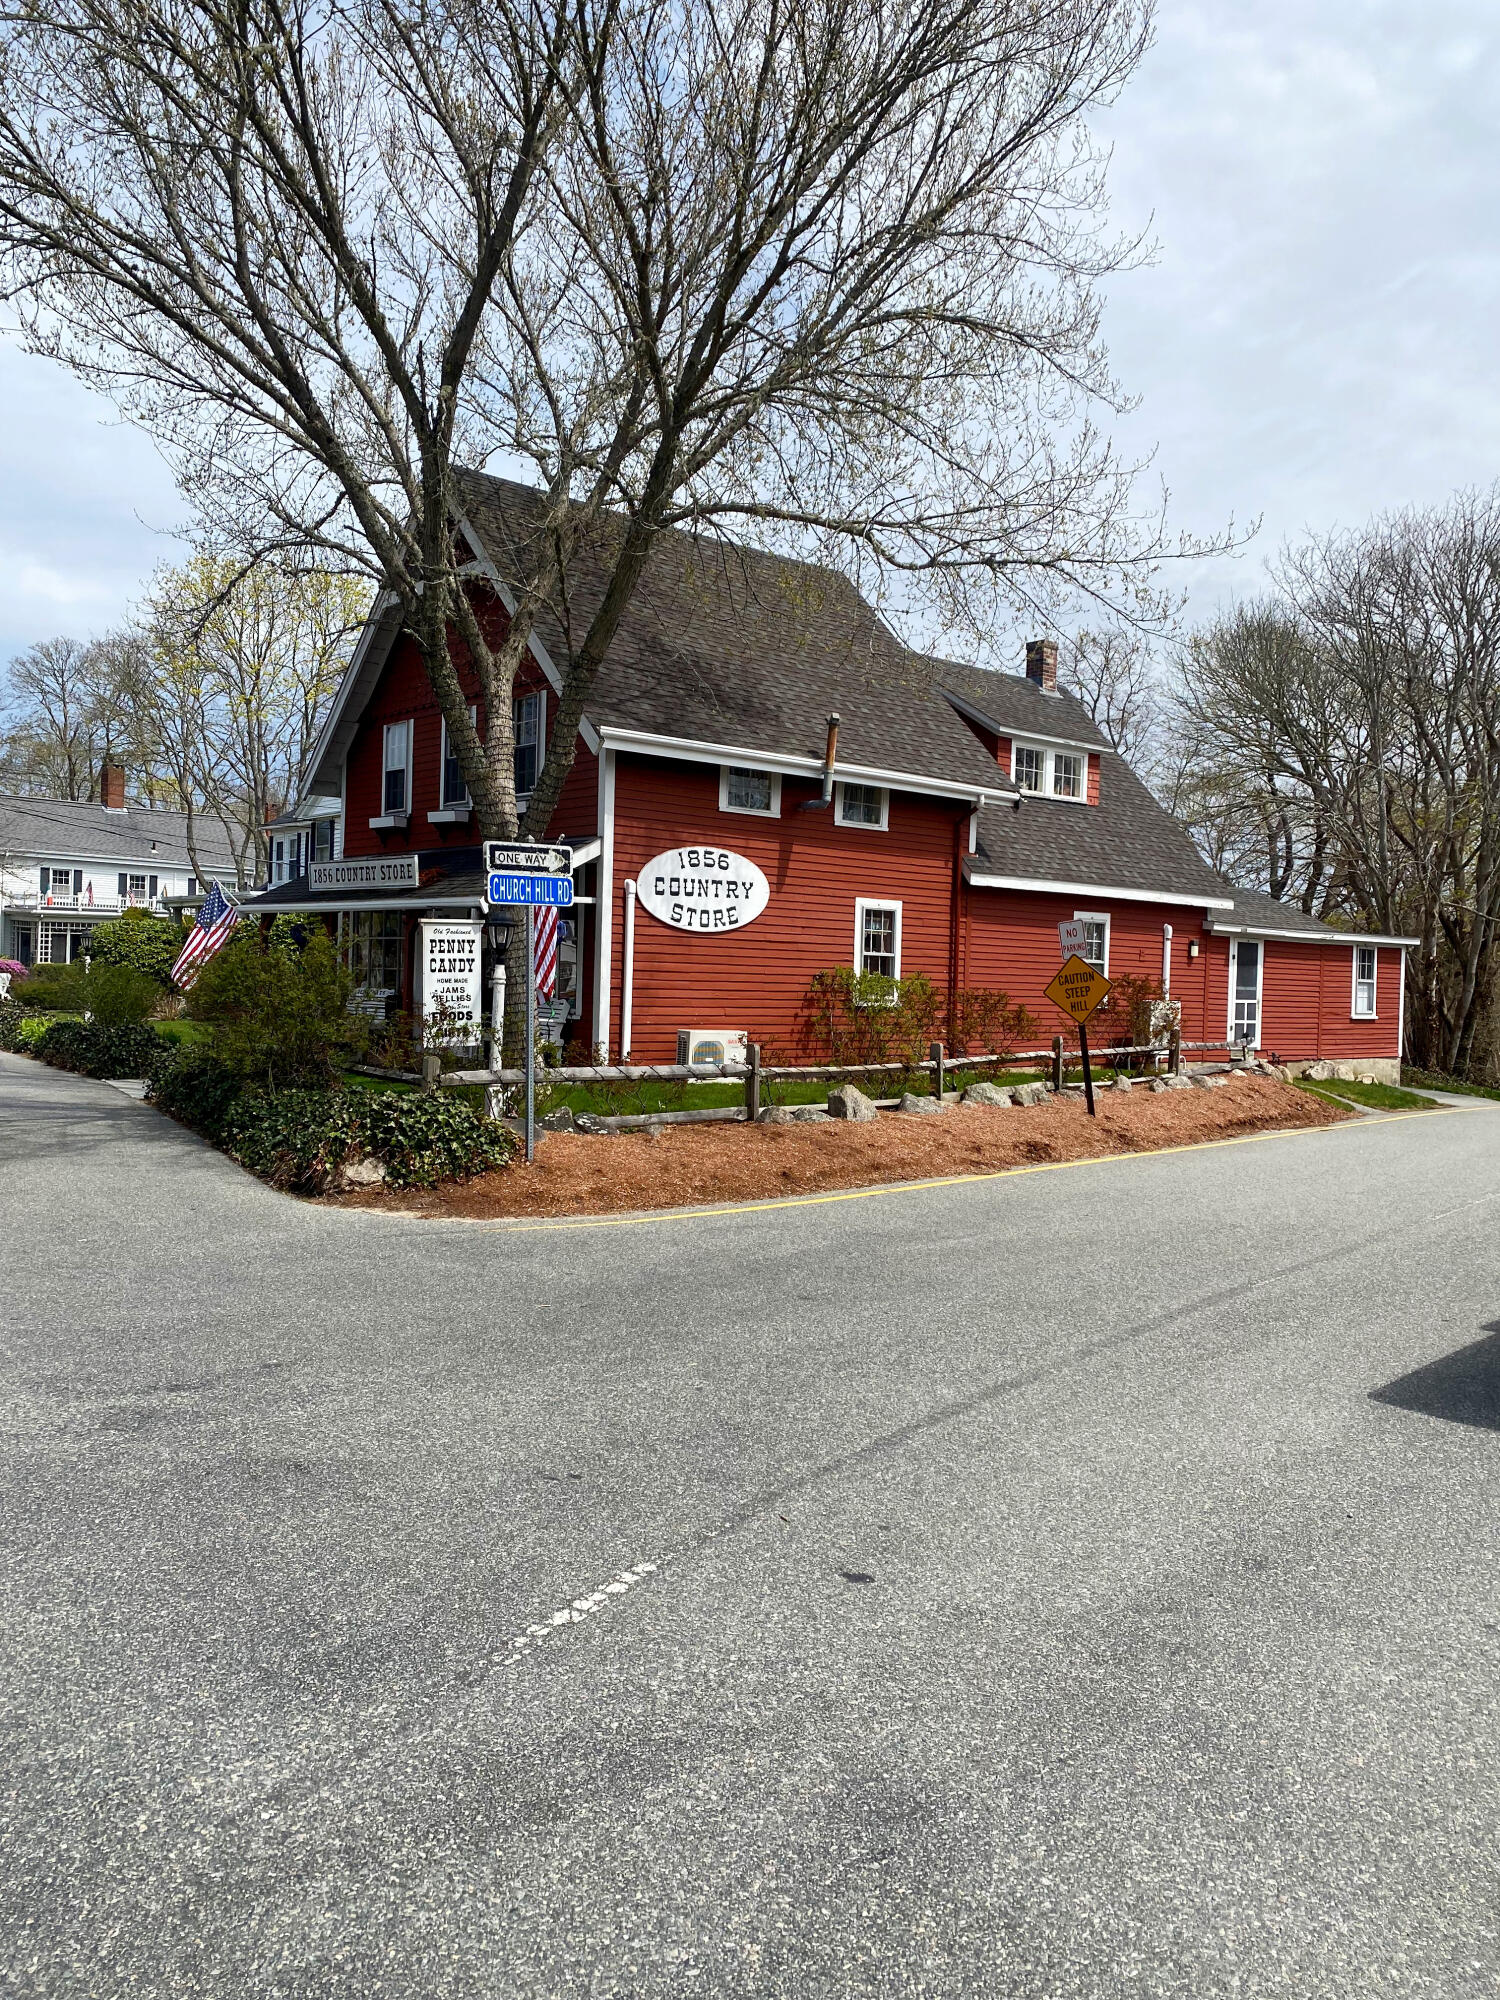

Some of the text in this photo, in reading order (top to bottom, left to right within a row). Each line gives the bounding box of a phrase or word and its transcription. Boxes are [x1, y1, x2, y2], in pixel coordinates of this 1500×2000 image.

[498, 852, 546, 866] ONE WAY
[679, 850, 729, 870] 1856
[314, 864, 412, 883] 1856 COUNTRY STORE
[493, 877, 570, 903] CHURCH HILL RD
[655, 877, 753, 899] COUNTRY
[671, 903, 738, 927] STORE
[1066, 927, 1078, 938] NO
[429, 939, 475, 953] PENNY
[1062, 943, 1085, 953] PARKING
[430, 958, 475, 972] CANDY
[1058, 971, 1095, 986] CAUTION
[433, 994, 472, 1002] JELLIES
[1064, 985, 1091, 999] STEEP
[1070, 1000, 1089, 1013] HILL
